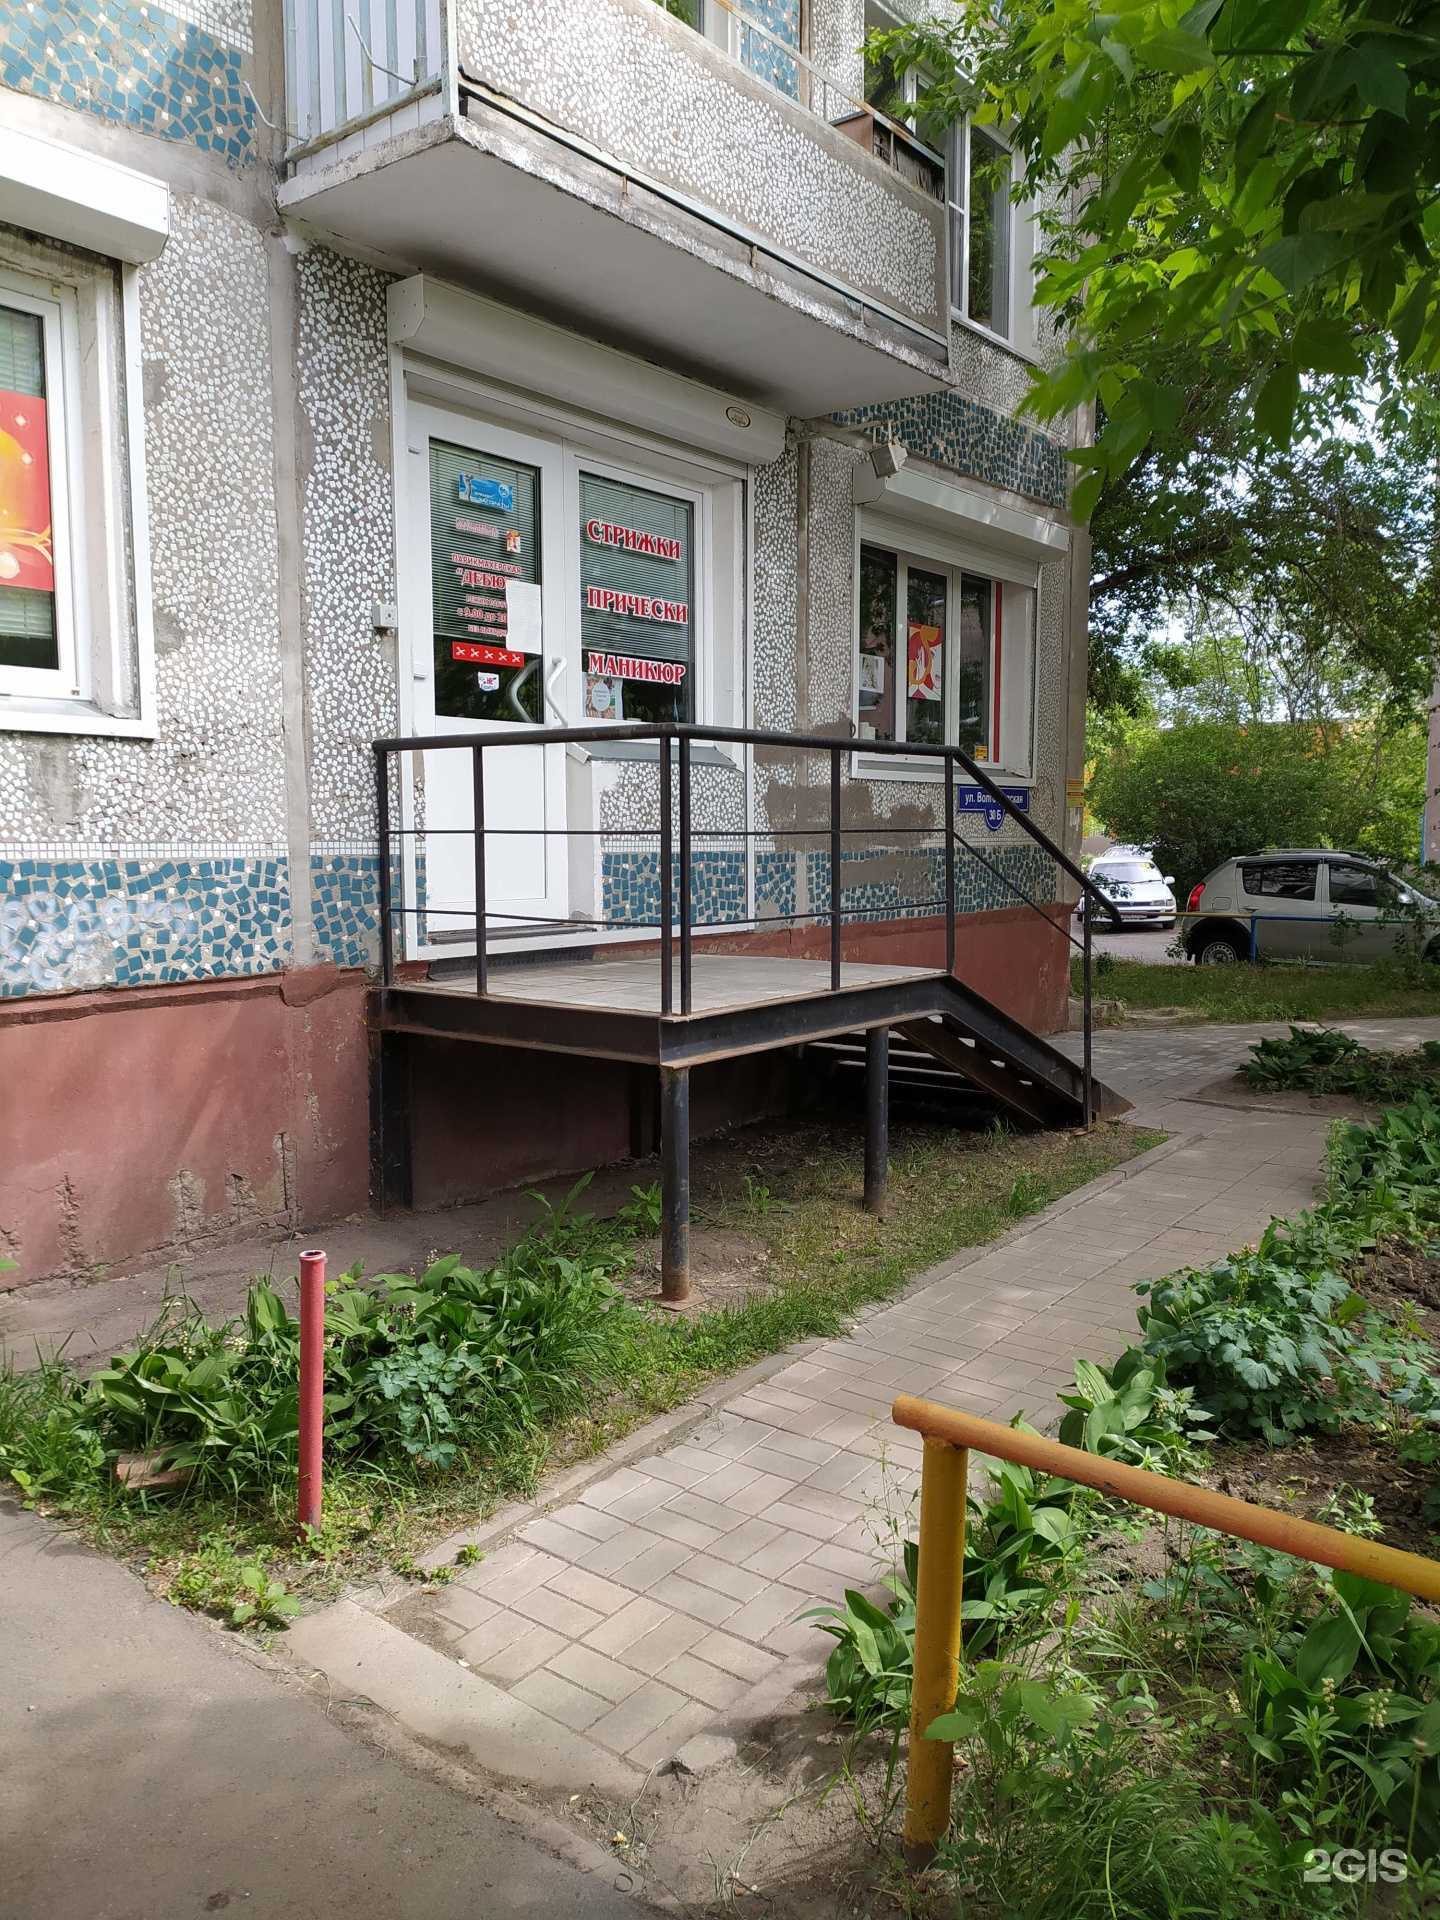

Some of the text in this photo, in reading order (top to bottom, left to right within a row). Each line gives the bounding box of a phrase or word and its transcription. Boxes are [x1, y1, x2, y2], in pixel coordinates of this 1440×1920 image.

[586, 519, 681, 560] СТРИЖКИ
[452, 552, 522, 575] ПАРИКМАХЕРСКАЯ
[456, 567, 507, 590] "ДЕБЮ
[587, 586, 688, 624] ПРИЧЕСКИ
[588, 652, 686, 685] МАНИКЮР
[965, 793, 976, 806] ул.
